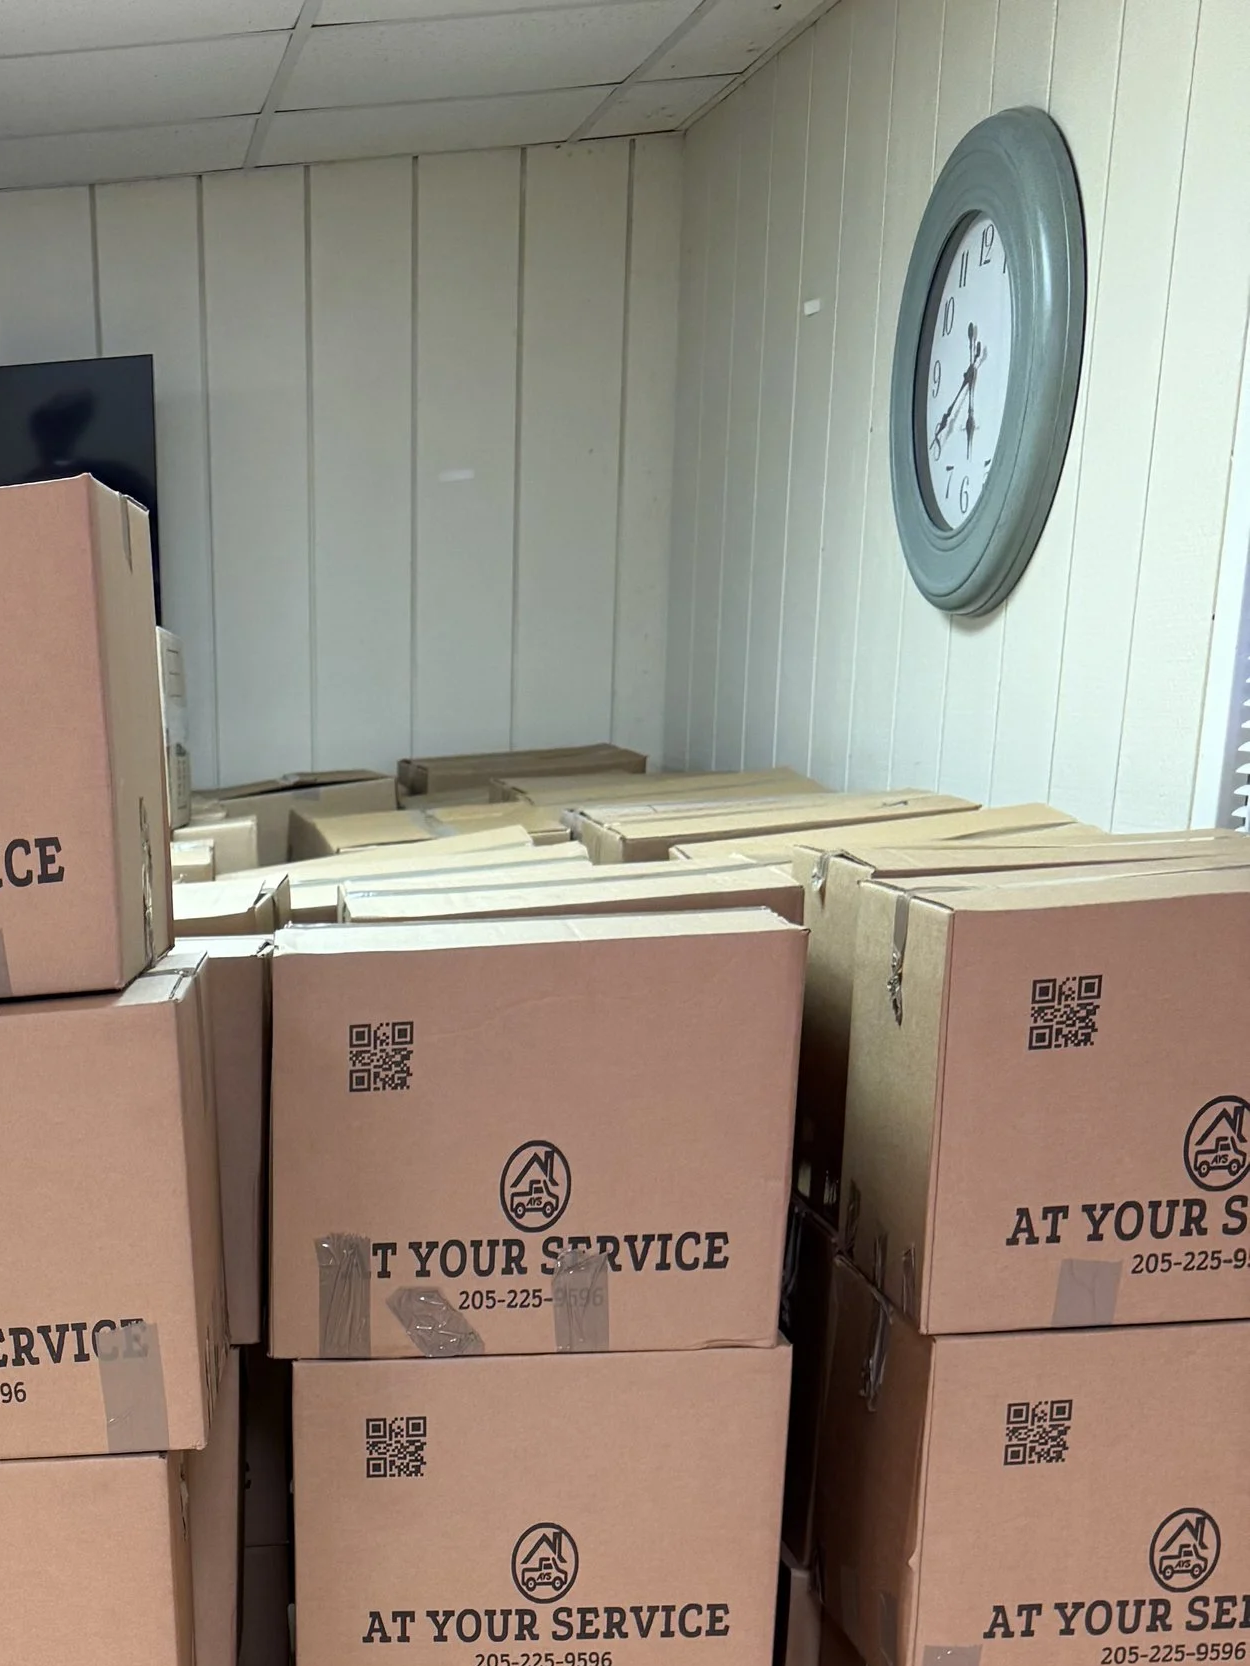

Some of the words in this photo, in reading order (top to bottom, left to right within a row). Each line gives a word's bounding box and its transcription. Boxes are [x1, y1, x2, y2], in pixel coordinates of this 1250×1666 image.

[979, 224, 995, 266] 12
[959, 250, 969, 288] 11
[942, 296, 955, 337] 10
[932, 360, 941, 398] 9
[946, 465, 954, 499] 7
[959, 475, 969, 514] 6
[1211, 1154, 1228, 1164] AYS
[526, 1197, 542, 1207] AYS
[1006, 1205, 1069, 1246] AT
[1082, 1199, 1208, 1241] YOUR
[408, 1239, 527, 1278] YOUR
[1131, 1248, 1250, 1275] 205-225-9
[536, 1572, 552, 1581] AYS
[1175, 1559, 1191, 1568] AYS
[362, 1611, 416, 1643] AT
[426, 1608, 539, 1642] YOUR
[551, 1603, 729, 1641] SERVICE
[983, 1604, 1043, 1639] AT
[1054, 1599, 1173, 1636] YOUR
[1101, 1642, 1247, 1665] 205-225-9596
